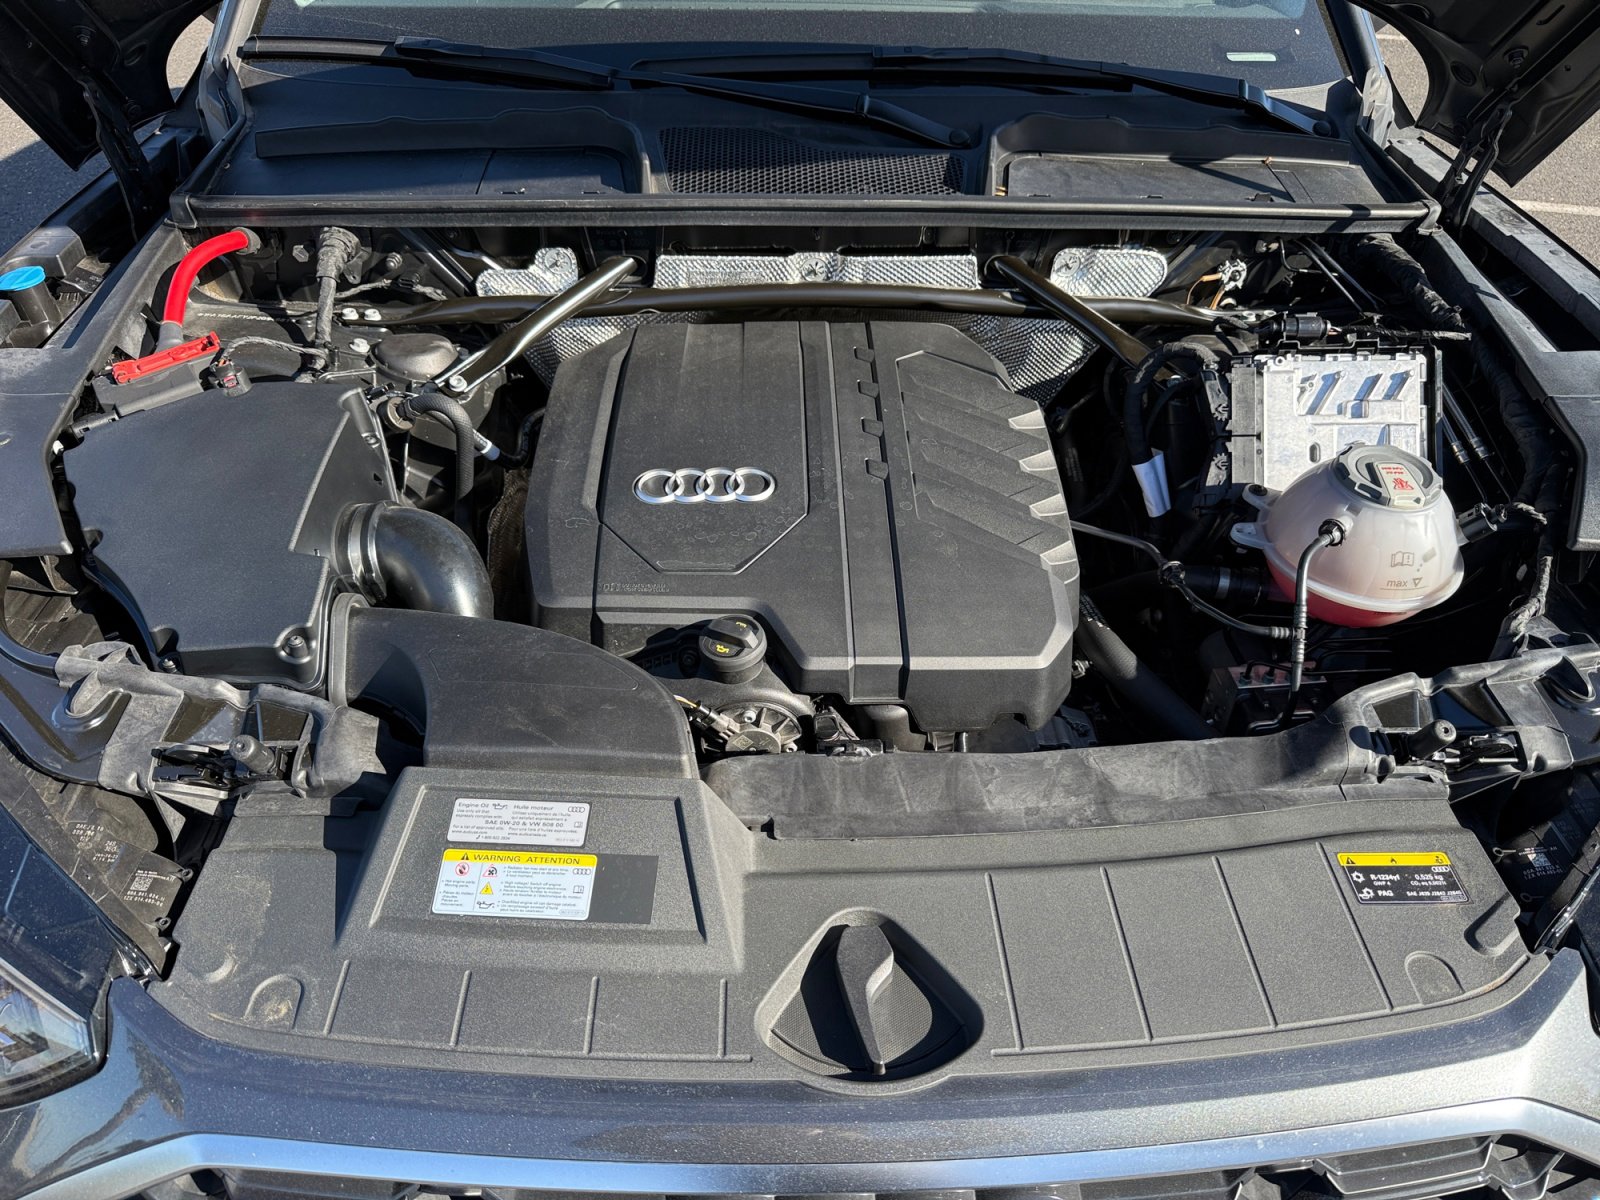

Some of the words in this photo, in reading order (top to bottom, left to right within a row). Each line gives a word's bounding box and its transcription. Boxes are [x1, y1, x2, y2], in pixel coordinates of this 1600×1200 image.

[1386, 579, 1408, 587] max
[473, 854, 521, 862] WARNING
[526, 856, 580, 865] ATTENTION
[1369, 874, 1400, 882] R-1234yf
